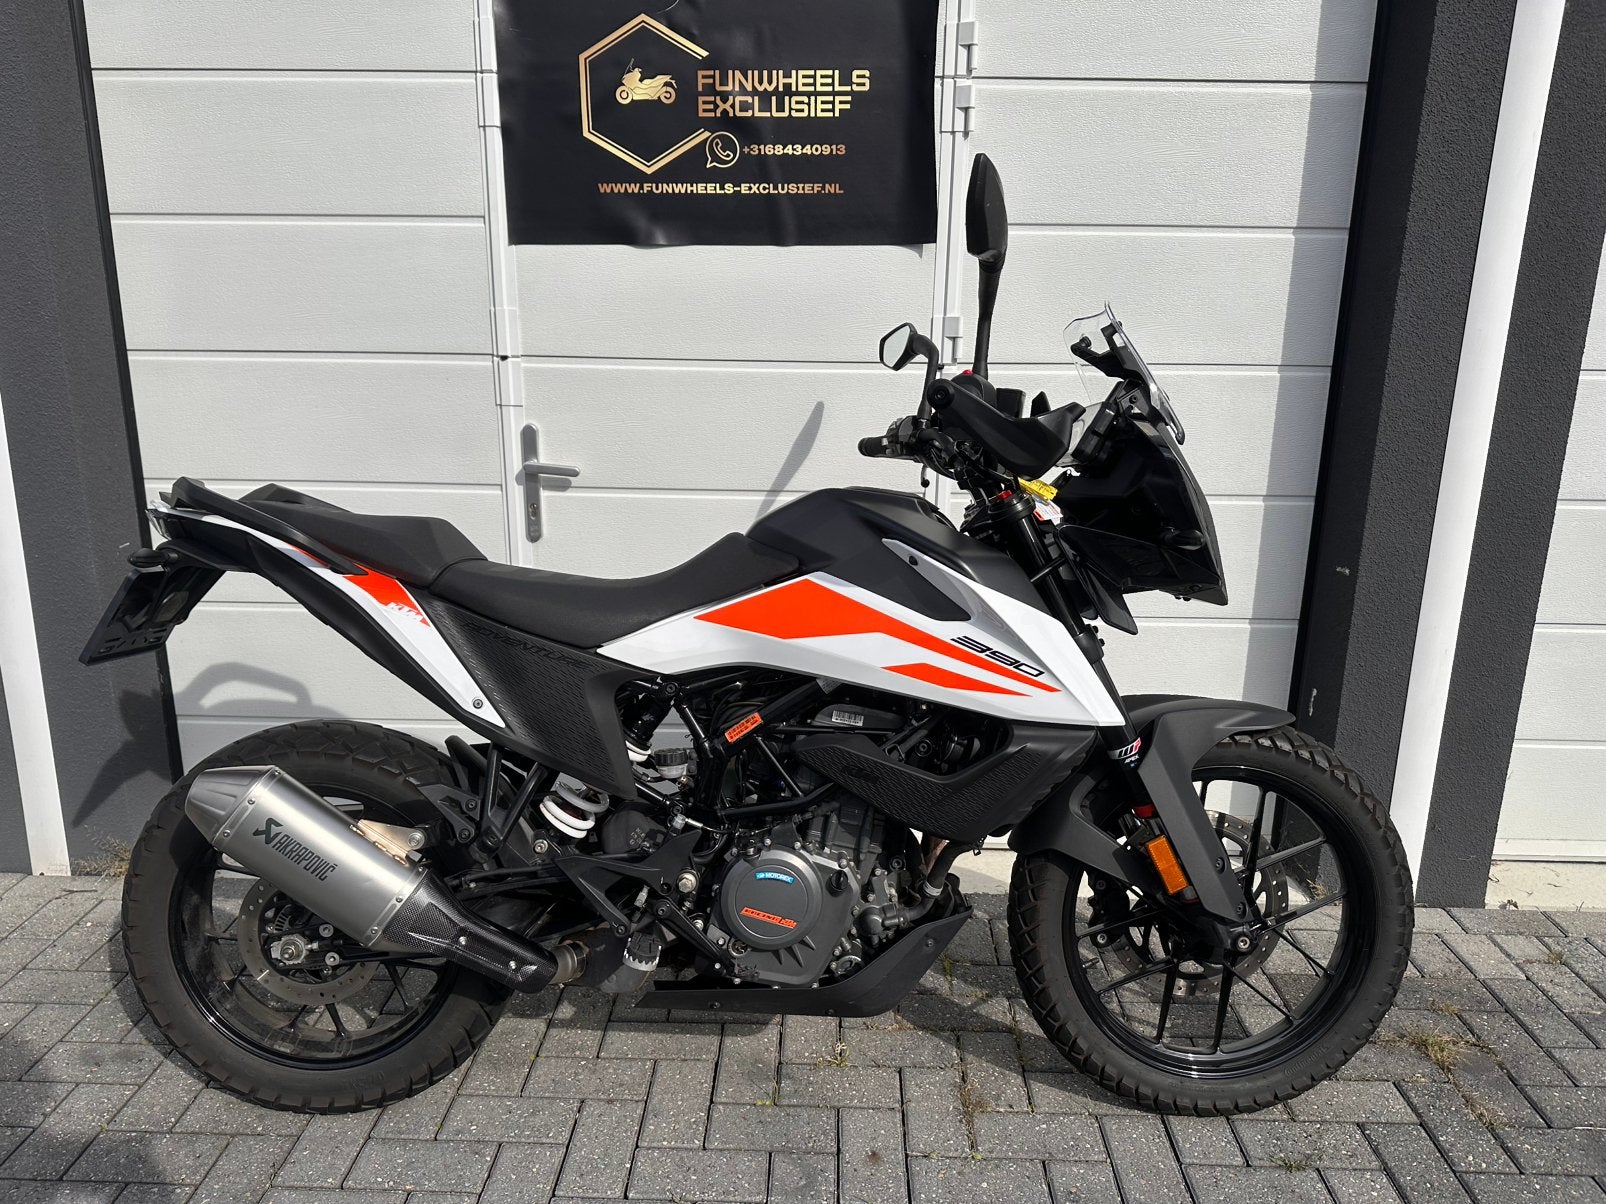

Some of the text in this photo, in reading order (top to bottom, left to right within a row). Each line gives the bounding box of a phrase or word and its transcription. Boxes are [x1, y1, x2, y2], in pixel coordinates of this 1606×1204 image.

[697, 70, 870, 91] FUNWHEELS
[697, 96, 852, 117] EXCLUSIEF
[742, 144, 846, 156] +31684340913
[598, 183, 844, 194] WWW.FUNWHEELS-EXCLUSIEF.NL
[950, 635, 1045, 678] 390
[765, 872, 792, 884] MOTOREX
